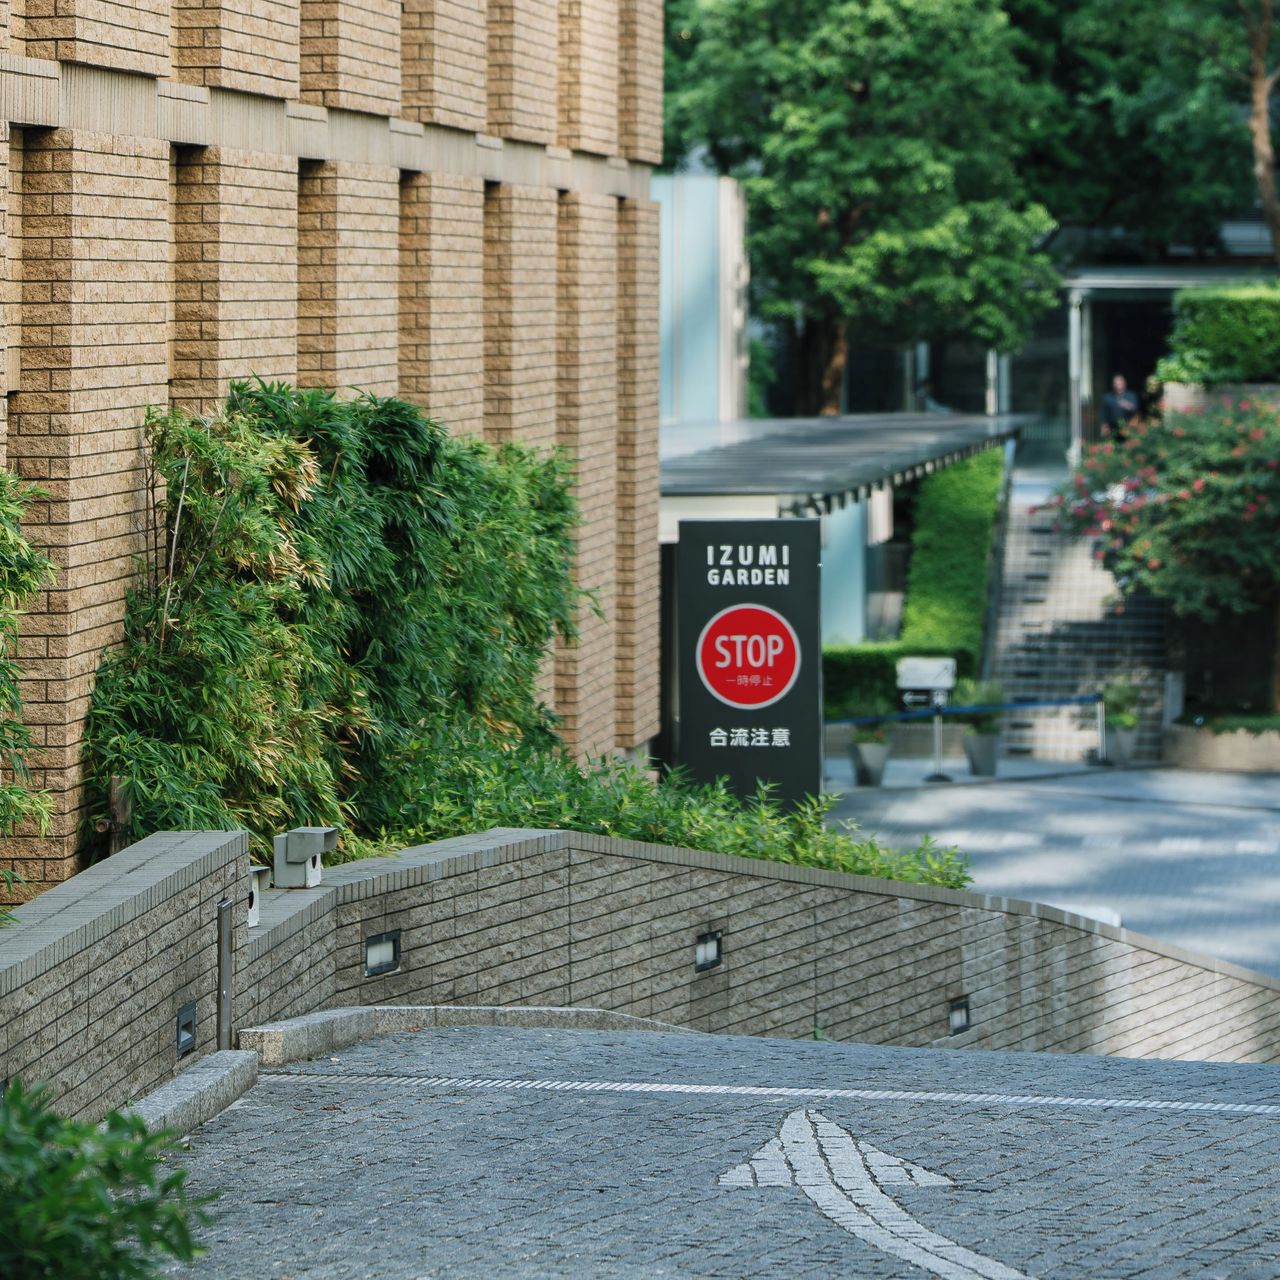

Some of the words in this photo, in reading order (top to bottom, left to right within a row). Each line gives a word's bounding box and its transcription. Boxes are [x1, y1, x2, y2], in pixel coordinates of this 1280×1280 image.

[706, 545, 790, 566] IZUMI
[707, 568, 790, 586] GARDEN
[714, 634, 784, 669] STOP
[709, 727, 791, 747] 合流注意
